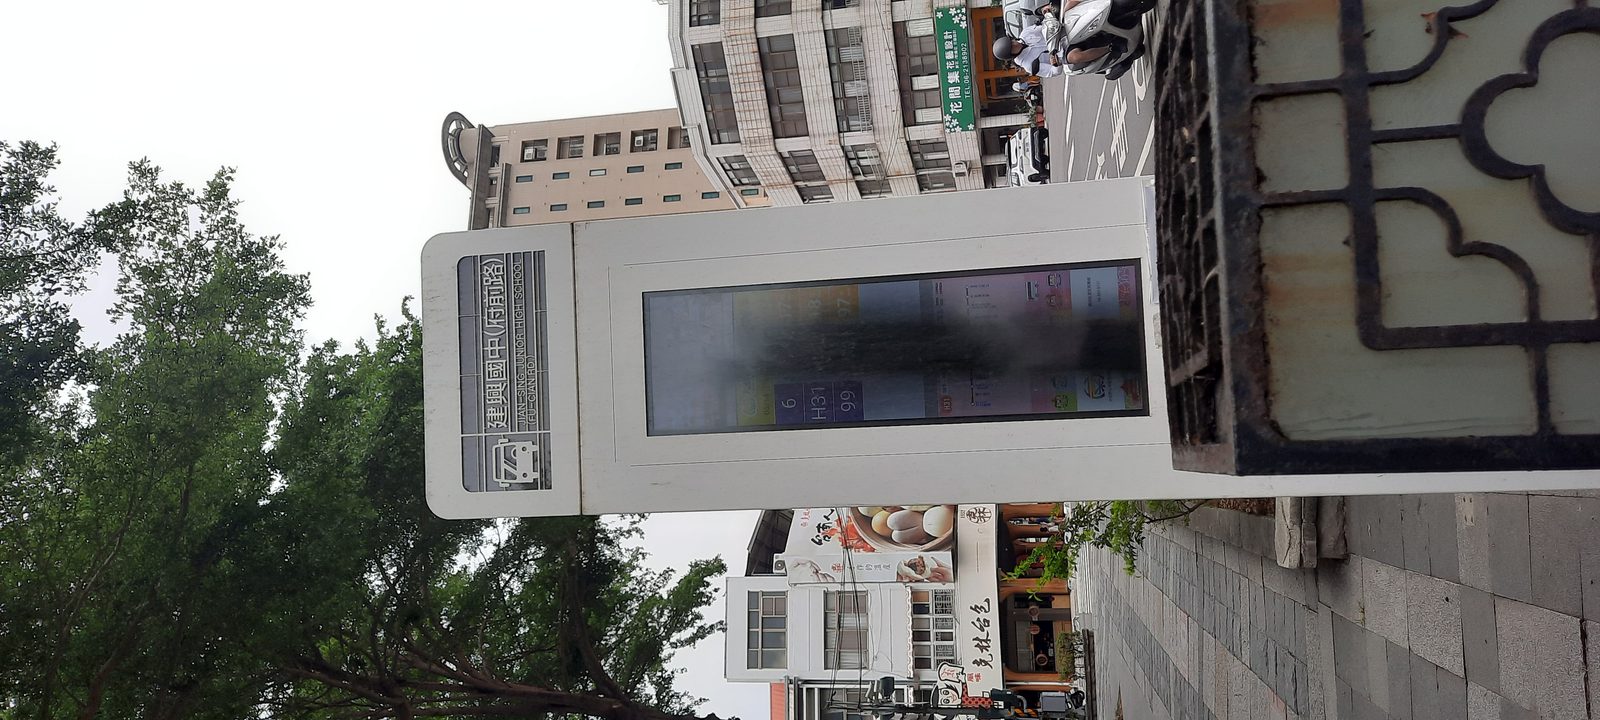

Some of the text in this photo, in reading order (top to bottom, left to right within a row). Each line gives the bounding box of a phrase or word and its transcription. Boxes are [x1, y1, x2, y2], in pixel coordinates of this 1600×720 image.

[944, 30, 955, 69] 花藝設計
[947, 71, 962, 114] 花間集
[482, 258, 508, 428] 建興國中(府前路)
[513, 259, 526, 425] JIAN-SING JUNIOR HIGH SCHOOL
[526, 377, 536, 425] (FU-CIAN
[782, 398, 796, 408] 6
[811, 387, 827, 419] H31
[840, 390, 856, 412] 99
[970, 598, 993, 669] 克林台包
